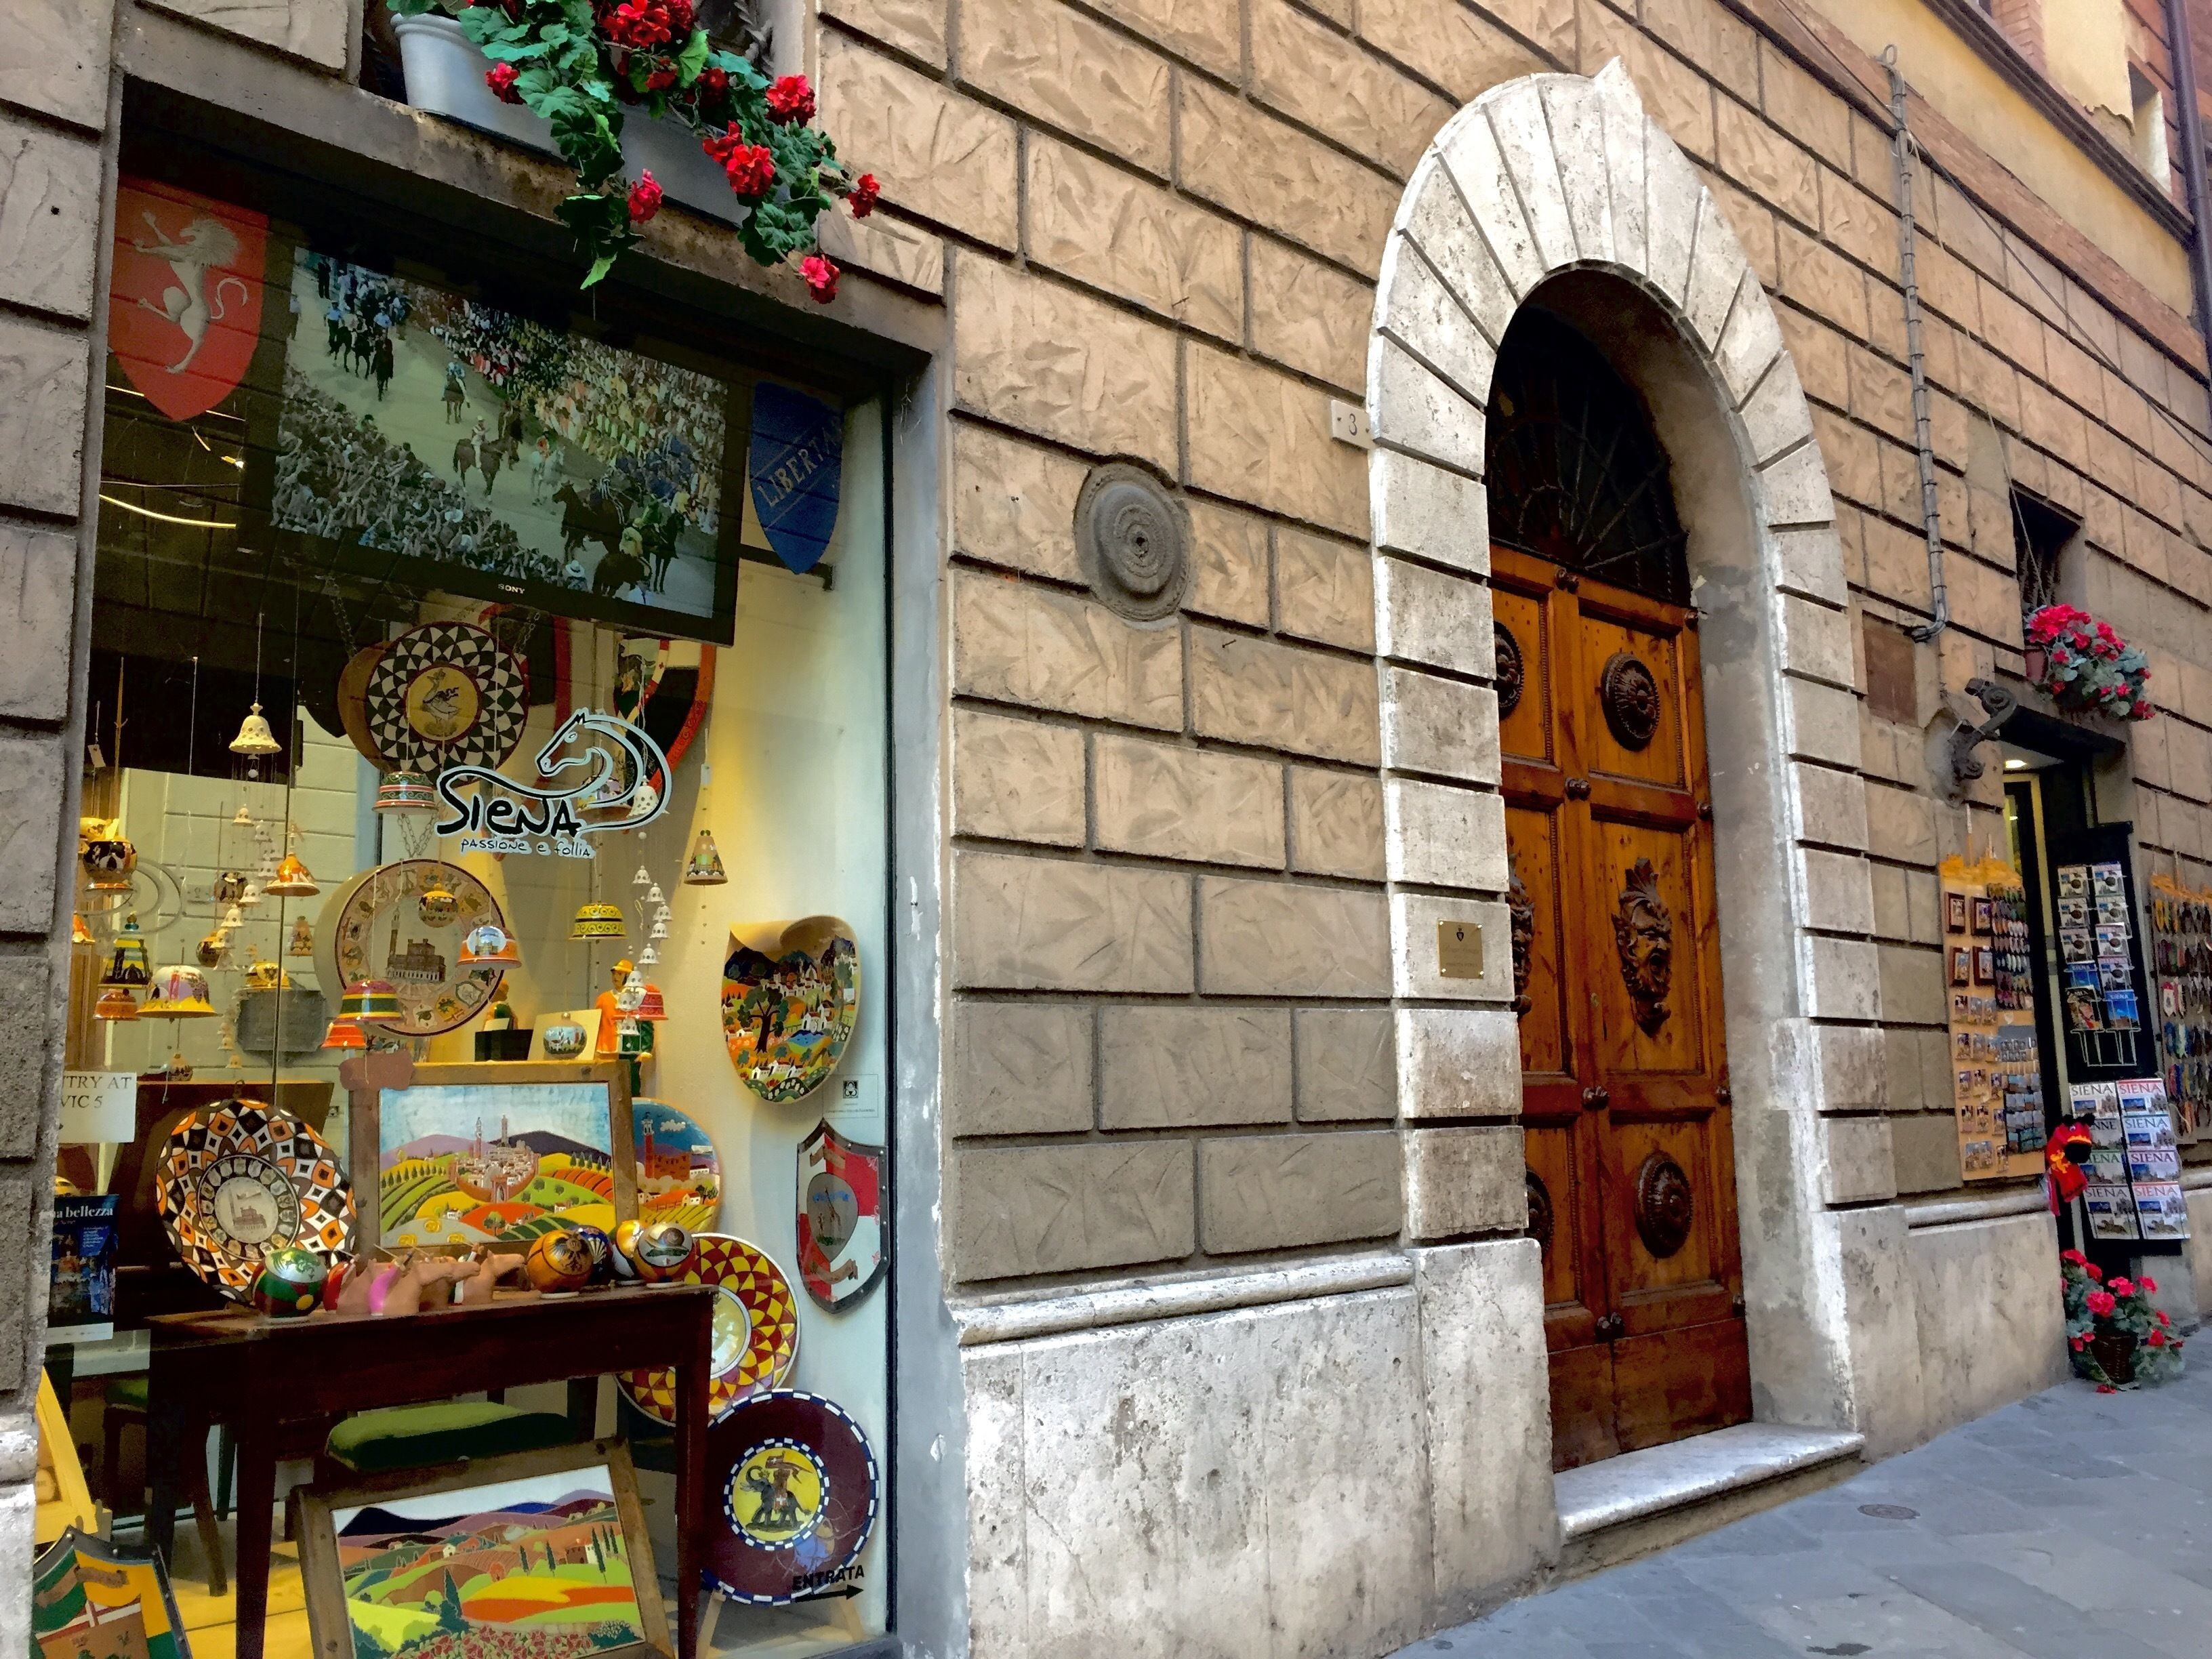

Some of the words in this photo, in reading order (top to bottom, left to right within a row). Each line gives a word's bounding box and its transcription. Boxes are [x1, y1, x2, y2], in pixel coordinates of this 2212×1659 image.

[1348, 413, 1358, 436] 3
[497, 583, 526, 594] SONY
[537, 843, 547, 853] e
[62, 1075, 102, 1088] TRY
[107, 1076, 132, 1089] AT
[2072, 1084, 2113, 1097] SIENA
[2118, 1083, 2163, 1095] SIENA
[94, 1096, 103, 1108] 5
[2125, 1117, 2169, 1129] SIENA
[2131, 1153, 2174, 1163] SIENA
[2085, 1187, 2127, 1198] SIENA
[2135, 1185, 2179, 1197] SIENA
[65, 1205, 114, 1218] bellezza
[792, 1565, 865, 1591] ENTRATA
